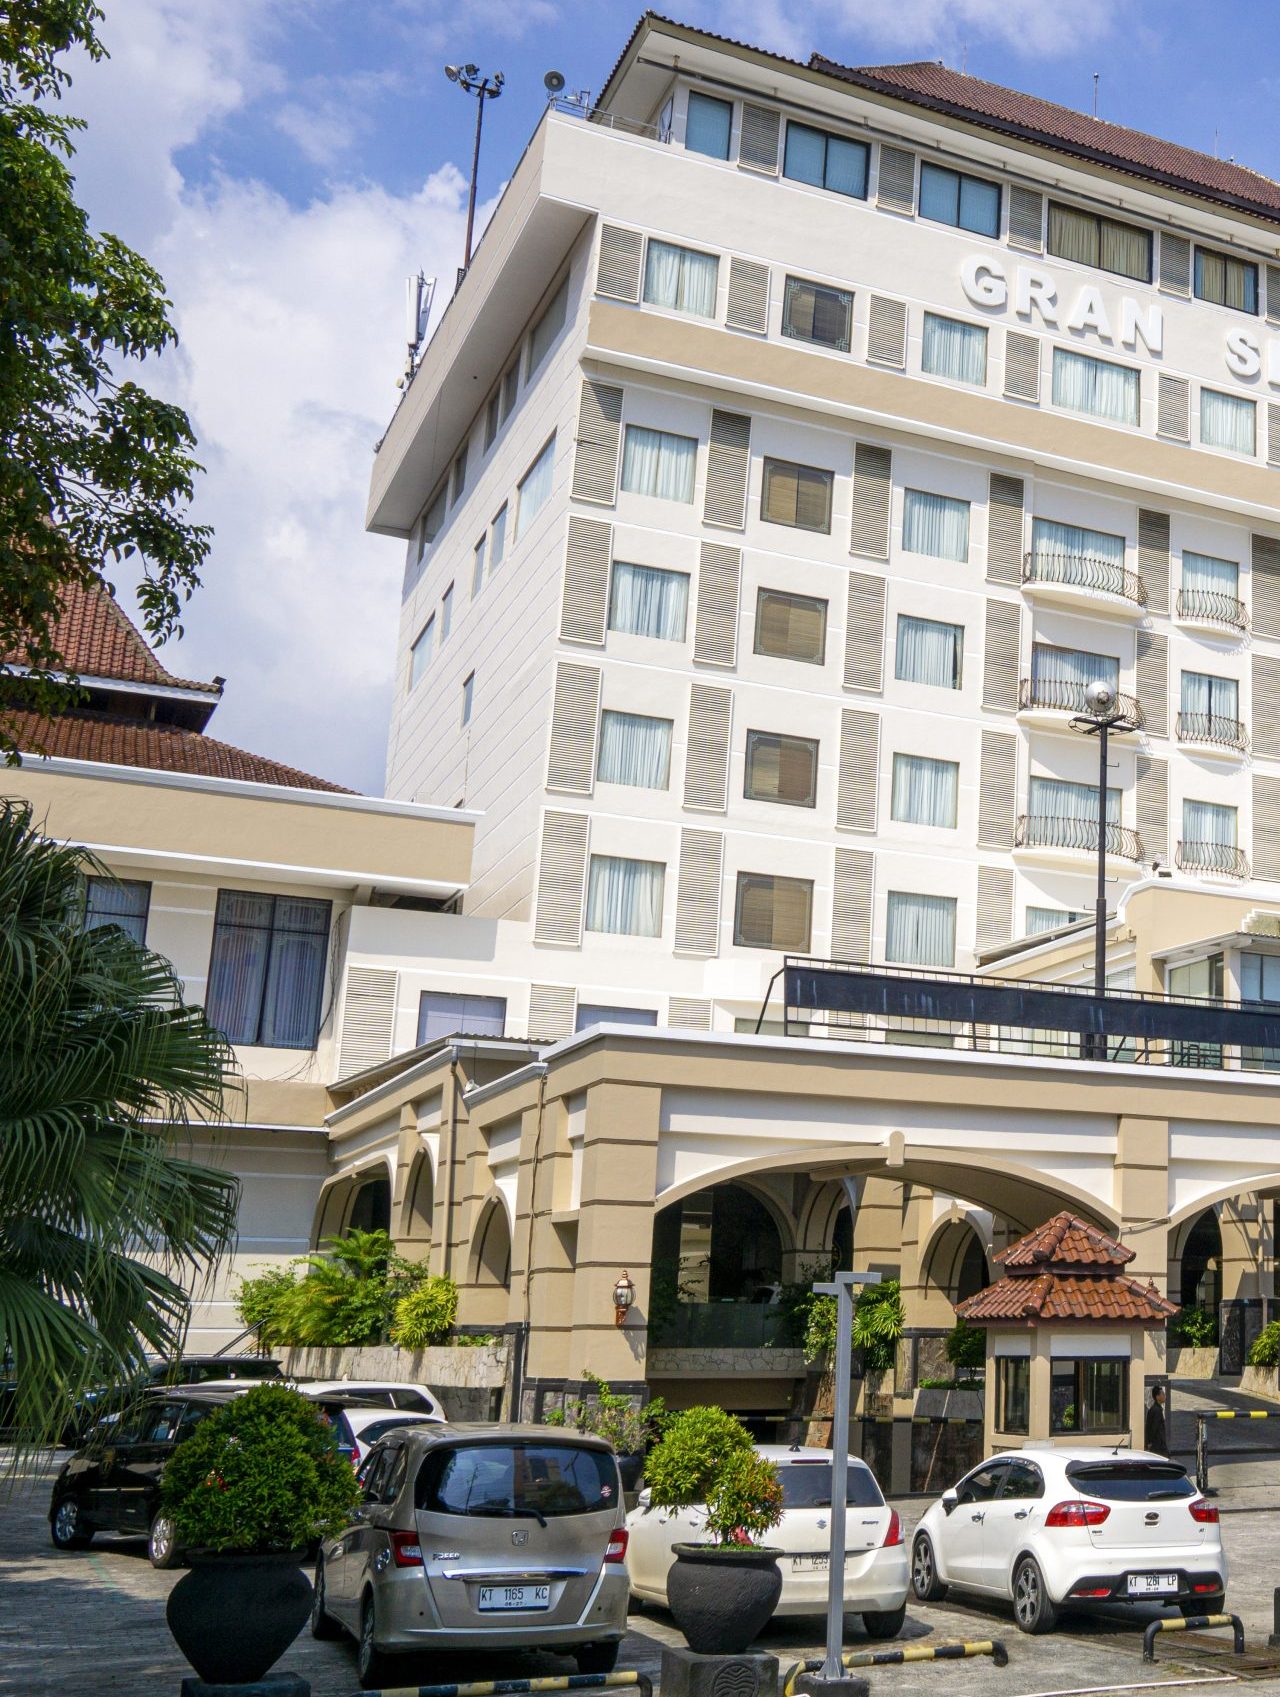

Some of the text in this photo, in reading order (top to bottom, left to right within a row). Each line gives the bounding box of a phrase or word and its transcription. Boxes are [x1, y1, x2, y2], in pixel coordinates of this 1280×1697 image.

[960, 253, 1164, 353] GRAN
[432, 1552, 460, 1561] FREED
[1130, 1577, 1138, 1587] KT
[1168, 1575, 1177, 1586] LP
[481, 1587, 548, 1601] KT 1165 KC
